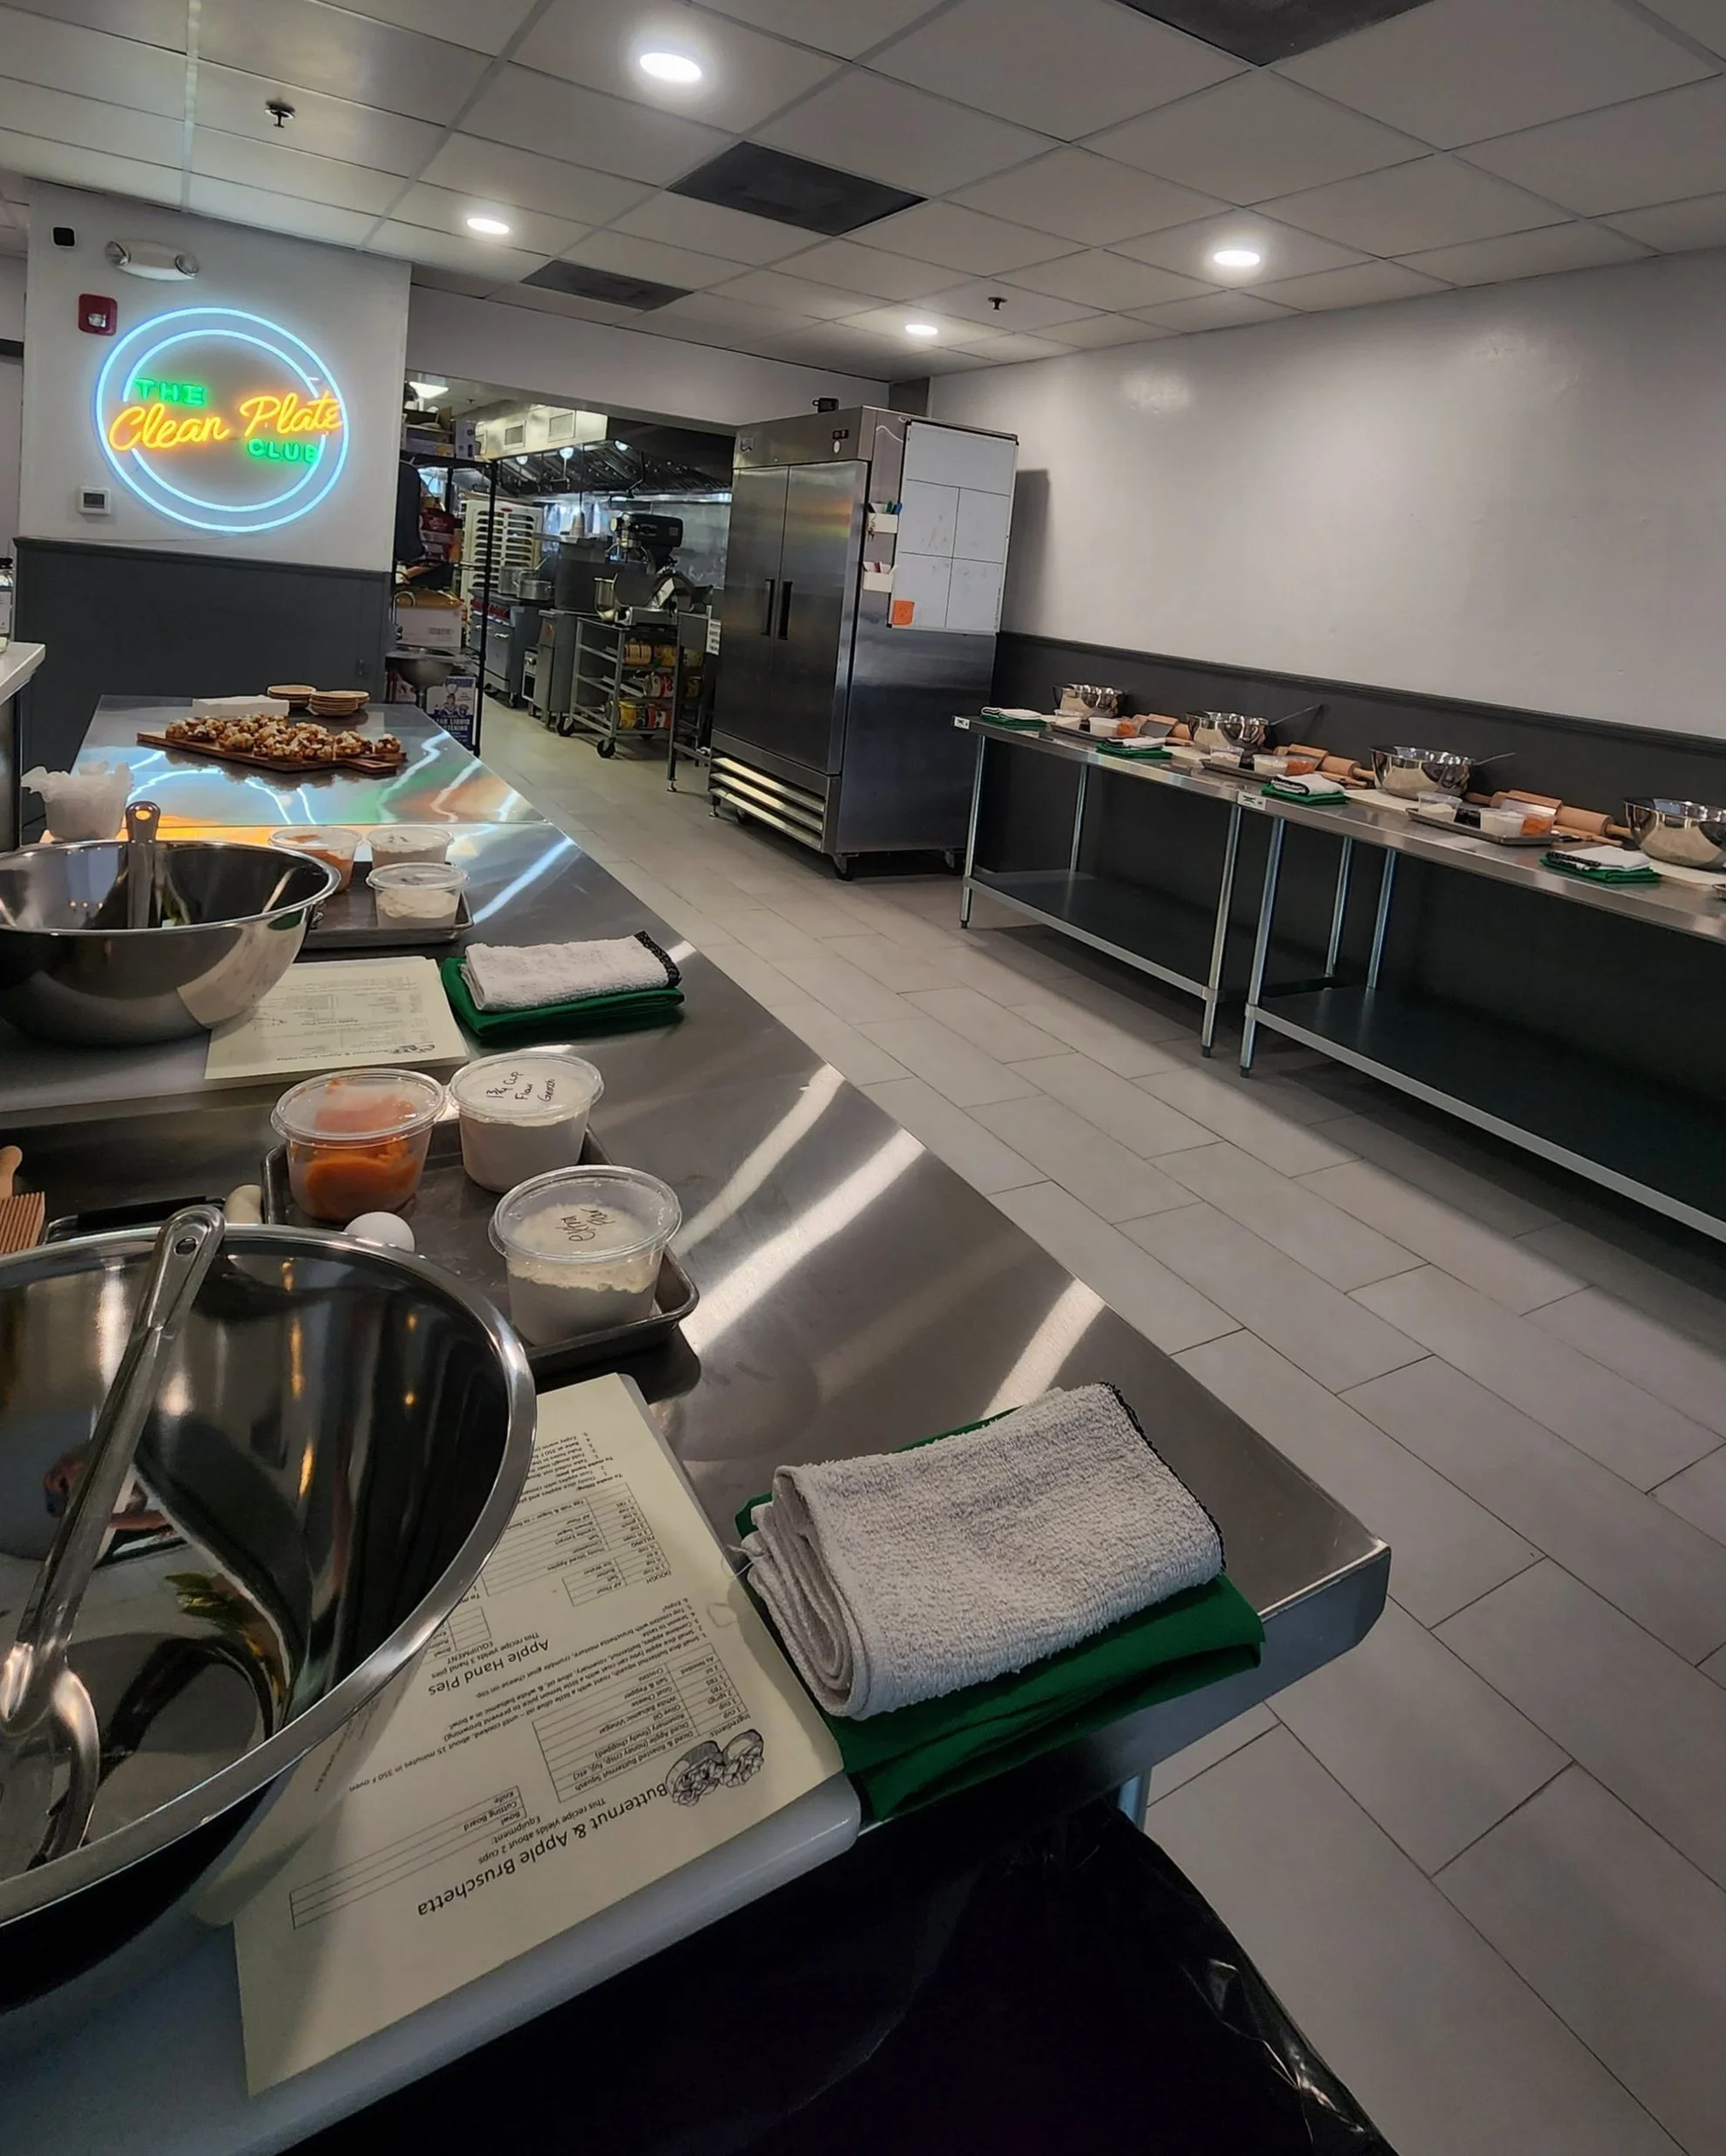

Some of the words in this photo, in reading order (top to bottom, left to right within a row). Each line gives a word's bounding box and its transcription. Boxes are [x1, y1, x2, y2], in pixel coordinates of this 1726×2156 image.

[135, 378, 205, 404] THE
[110, 403, 230, 450] Clean
[240, 392, 342, 436] Plate
[247, 438, 318, 463] CLUB
[646, 1570, 671, 1584] DOUGH
[448, 1641, 493, 1666] EQUIPMENT
[507, 1639, 549, 1662] Apple
[636, 1650, 669, 1666] butternut
[464, 1659, 504, 1683] Hand
[429, 1676, 460, 1695] Pies
[626, 1704, 655, 1723] Balsamic
[652, 1713, 685, 1732] Rosemary
[599, 1718, 626, 1735] Vinegar
[629, 1727, 652, 1742] (finely
[594, 1739, 629, 1760] chopped)
[624, 1739, 648, 1756] (honey
[638, 1744, 666, 1761] Roasted
[404, 1751, 436, 1768] minutes
[603, 1758, 638, 1779] Butternut
[575, 1774, 601, 1791] Squash
[488, 1798, 518, 1819] Cutting
[561, 1805, 587, 1822] recipe
[589, 1782, 669, 1829] Butternut
[464, 1815, 488, 1831] Board
[500, 1810, 521, 1826] Bowl
[535, 1817, 561, 1836] yields
[491, 1815, 542, 1845] Equipment:
[509, 1831, 533, 1850] about
[519, 1831, 568, 1864] Apple
[477, 1848, 498, 1864] cups
[418, 1859, 516, 1915] Bruschetta
